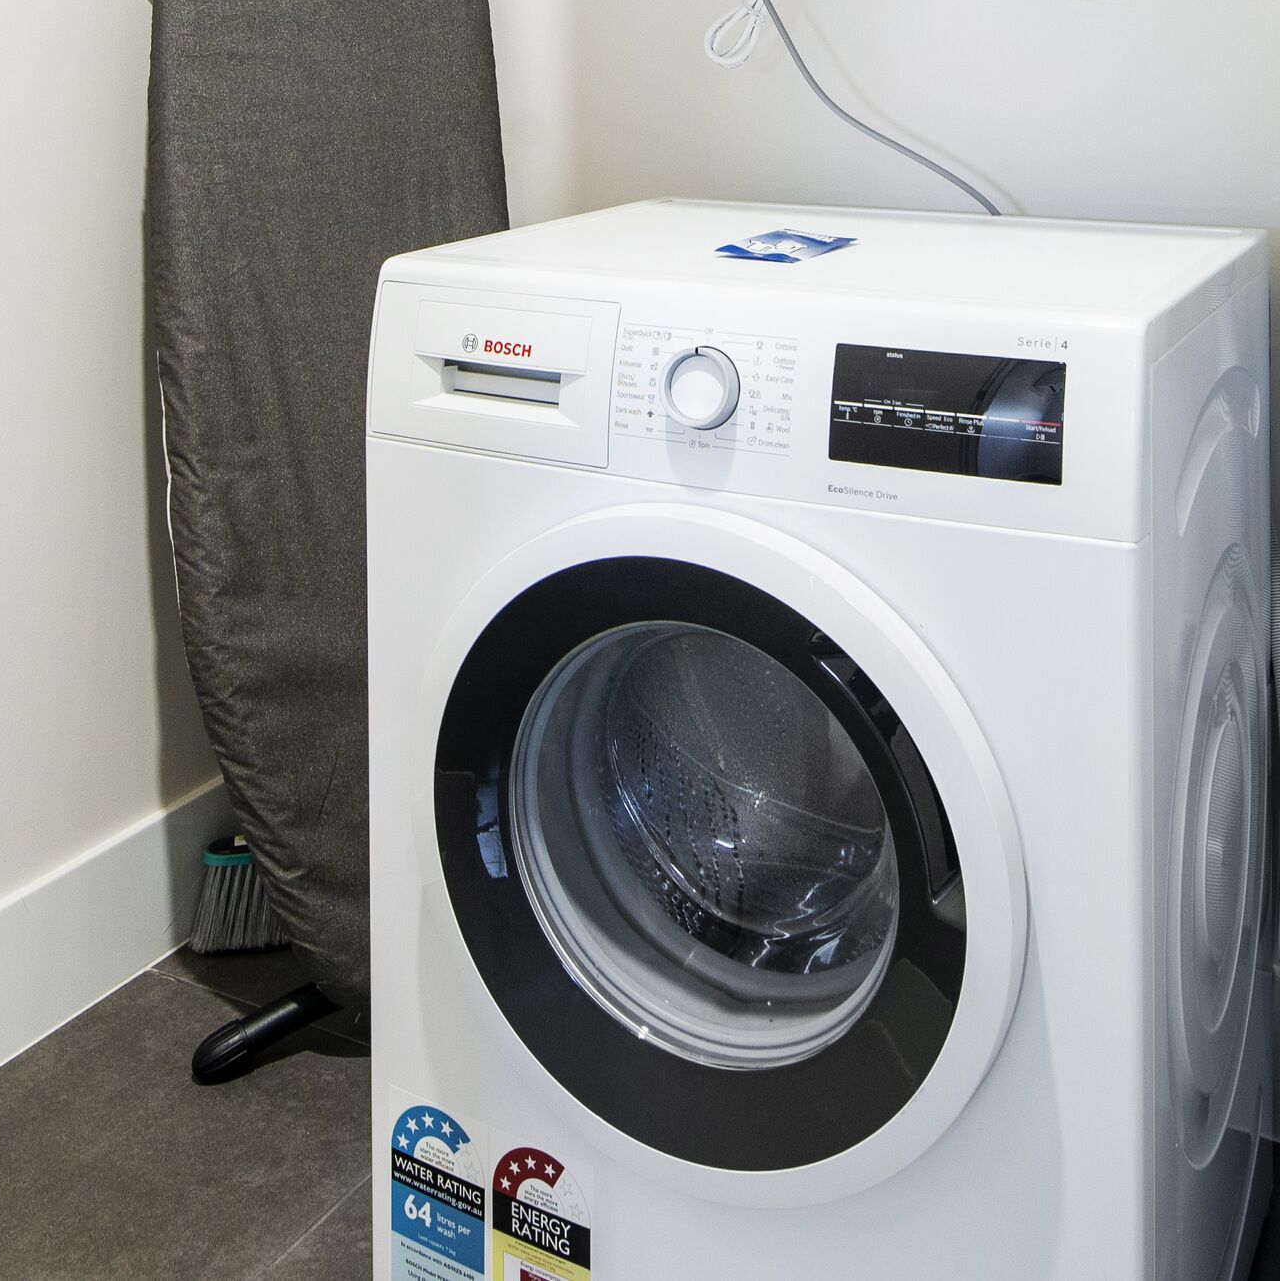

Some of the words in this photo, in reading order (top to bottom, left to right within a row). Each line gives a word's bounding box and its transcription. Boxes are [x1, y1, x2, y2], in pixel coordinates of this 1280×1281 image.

[483, 339, 532, 358] BOSCH
[1017, 336, 1052, 349] Serie
[1061, 340, 1069, 350] 4
[886, 351, 904, 359] status
[615, 406, 629, 415] Dark
[628, 407, 642, 416] wash
[614, 420, 630, 429] Rinse
[776, 424, 791, 434] Wool
[698, 440, 711, 450] Spin
[758, 437, 774, 447] Drum
[774, 440, 790, 450] clean
[827, 484, 874, 498] EcoSilence
[876, 490, 898, 501] Drive
[394, 1154, 434, 1184] WATER
[437, 1174, 482, 1205] RATING
[393, 1170, 483, 1217] www.waterrating.gov.au
[404, 1193, 432, 1229] 64
[436, 1212, 456, 1230] litres
[457, 1224, 472, 1236] per
[511, 1201, 571, 1239] ENERGY
[436, 1224, 456, 1240] wash
[512, 1218, 570, 1256] RATING
